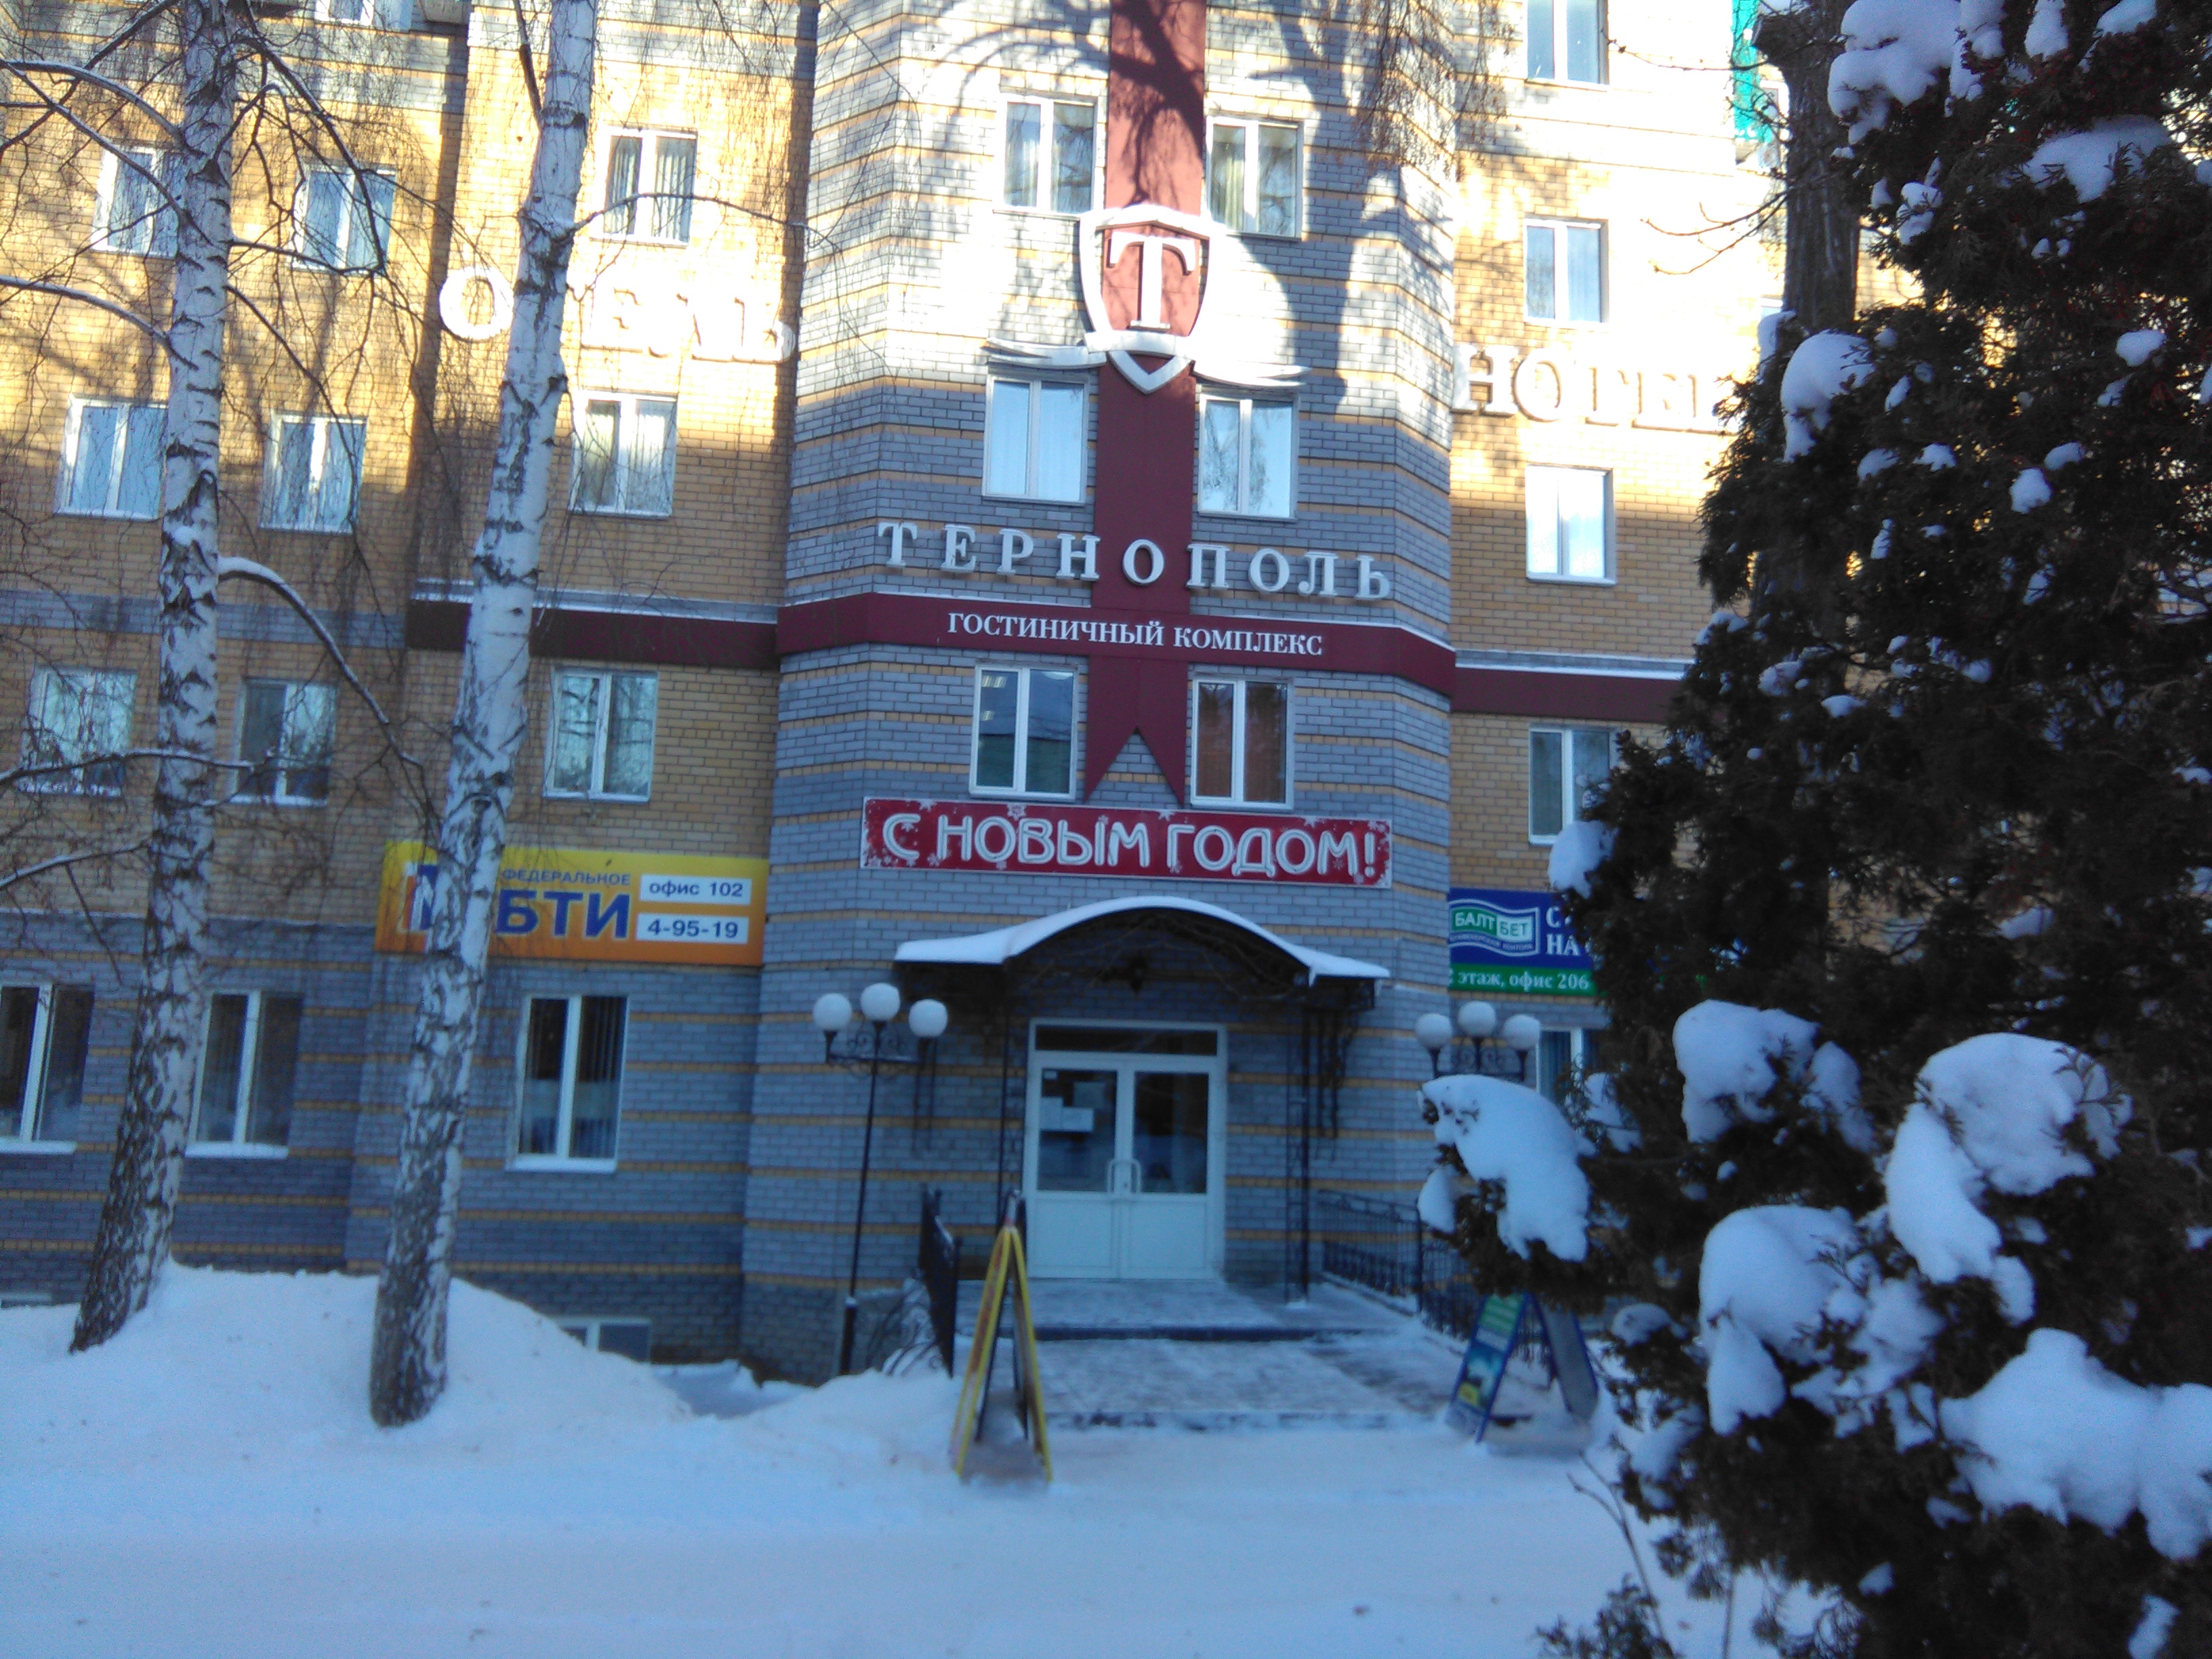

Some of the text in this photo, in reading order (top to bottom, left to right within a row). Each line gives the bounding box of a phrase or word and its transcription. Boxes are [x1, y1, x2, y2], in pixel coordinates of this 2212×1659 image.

[439, 266, 796, 366] ОЕЛЬ
[877, 521, 1392, 601] ТЕРНОПОЛЬ
[947, 611, 1324, 657] ГОСТИНИЧНЫЙ КОМПЛЕКС
[882, 813, 1376, 878] С НОВЫМ ГОДОМ!
[501, 868, 631, 886] ФЕДЕРАЛЬНОЕ
[648, 880, 743, 901] офис 102
[494, 888, 631, 939] БТИ
[647, 918, 739, 939] 4-95-19
[1509, 971, 1553, 992] офис
[1556, 974, 1590, 991] 206
